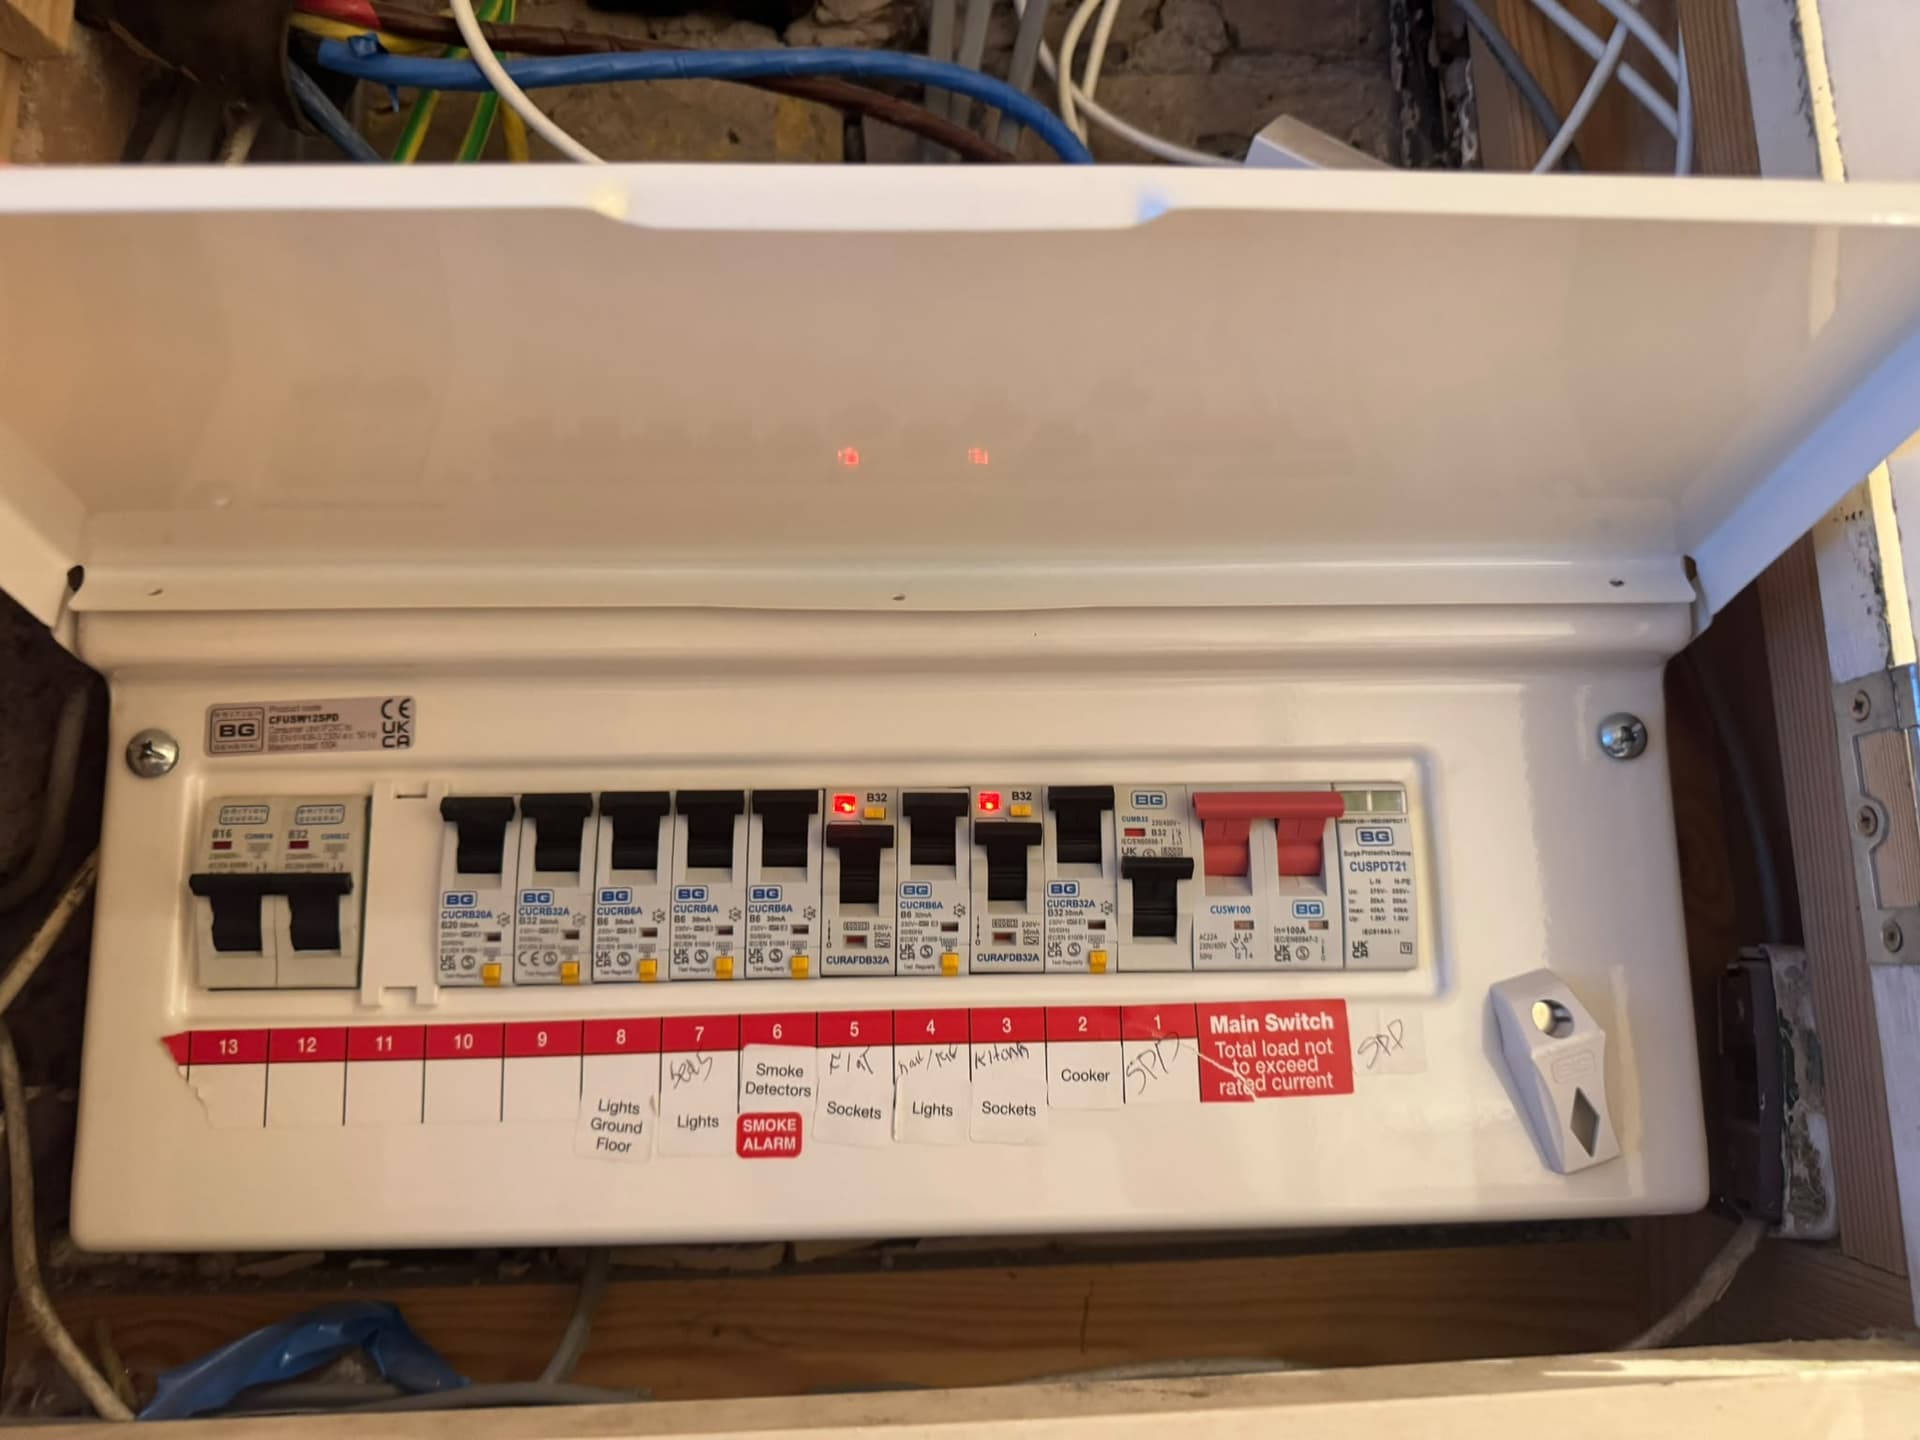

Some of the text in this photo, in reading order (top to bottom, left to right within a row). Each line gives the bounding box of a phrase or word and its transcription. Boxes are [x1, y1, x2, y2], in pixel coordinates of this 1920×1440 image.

[219, 723, 255, 737] BG
[866, 792, 888, 802] B32
[1011, 791, 1032, 801] B32
[1135, 795, 1163, 805] BG
[1151, 829, 1167, 837] B32
[1360, 831, 1390, 842] BG
[1122, 847, 1137, 856] UK
[1350, 861, 1407, 872] CUSPDT21
[678, 888, 705, 899] BG
[753, 888, 779, 899] BG
[903, 885, 929, 895] BG
[1051, 884, 1076, 894] BG
[446, 894, 474, 905] BG
[523, 893, 551, 904] BG
[601, 891, 629, 902] BG
[673, 905, 719, 913] CUCRB6A
[749, 904, 793, 912] CUCRB6A
[900, 901, 944, 909] CUCRB6A
[1047, 900, 1095, 908] CUCRB32A
[1210, 905, 1251, 915] CUSW100
[1296, 904, 1321, 915] BG
[441, 910, 493, 919] CUCRB20A
[518, 907, 570, 916] CUCRB32A
[597, 907, 643, 916] CUCRB6A
[1048, 909, 1063, 917] B32
[441, 921, 458, 929] B20
[519, 917, 537, 925] B32
[1352, 941, 1368, 949] UK
[826, 955, 889, 965] CURAFDB32A
[977, 953, 1040, 962] CURAFDB32A
[926, 1019, 936, 1035] 4
[1002, 1017, 1012, 1033] 3
[1078, 1016, 1088, 1033] 2
[1153, 1014, 1161, 1030] 1
[1209, 1011, 1334, 1035] Main Switch
[695, 1027, 705, 1042] 7
[772, 1023, 782, 1039] 6
[850, 1021, 860, 1038] 5
[375, 1036, 394, 1051] 11
[454, 1033, 474, 1050] 10
[537, 1031, 548, 1048] 9
[616, 1029, 626, 1045] 8
[219, 1038, 239, 1055] 13
[298, 1037, 318, 1054] 12
[1215, 1037, 1334, 1059] Total load not
[756, 1062, 804, 1078] Smoke
[1232, 1055, 1319, 1075] to exceed
[1061, 1068, 1111, 1083] Cooker
[745, 1081, 812, 1098] Detectors
[1219, 1072, 1334, 1096] rated current
[598, 1098, 641, 1116] Lights
[826, 1101, 882, 1120] Sockets
[912, 1101, 953, 1118] Lights
[981, 1101, 1037, 1117] Sockets
[590, 1117, 643, 1135] Ground
[677, 1114, 719, 1131] Lights
[743, 1118, 797, 1133] SMOKE
[596, 1137, 632, 1153] Floor
[743, 1136, 796, 1151] ALARM
